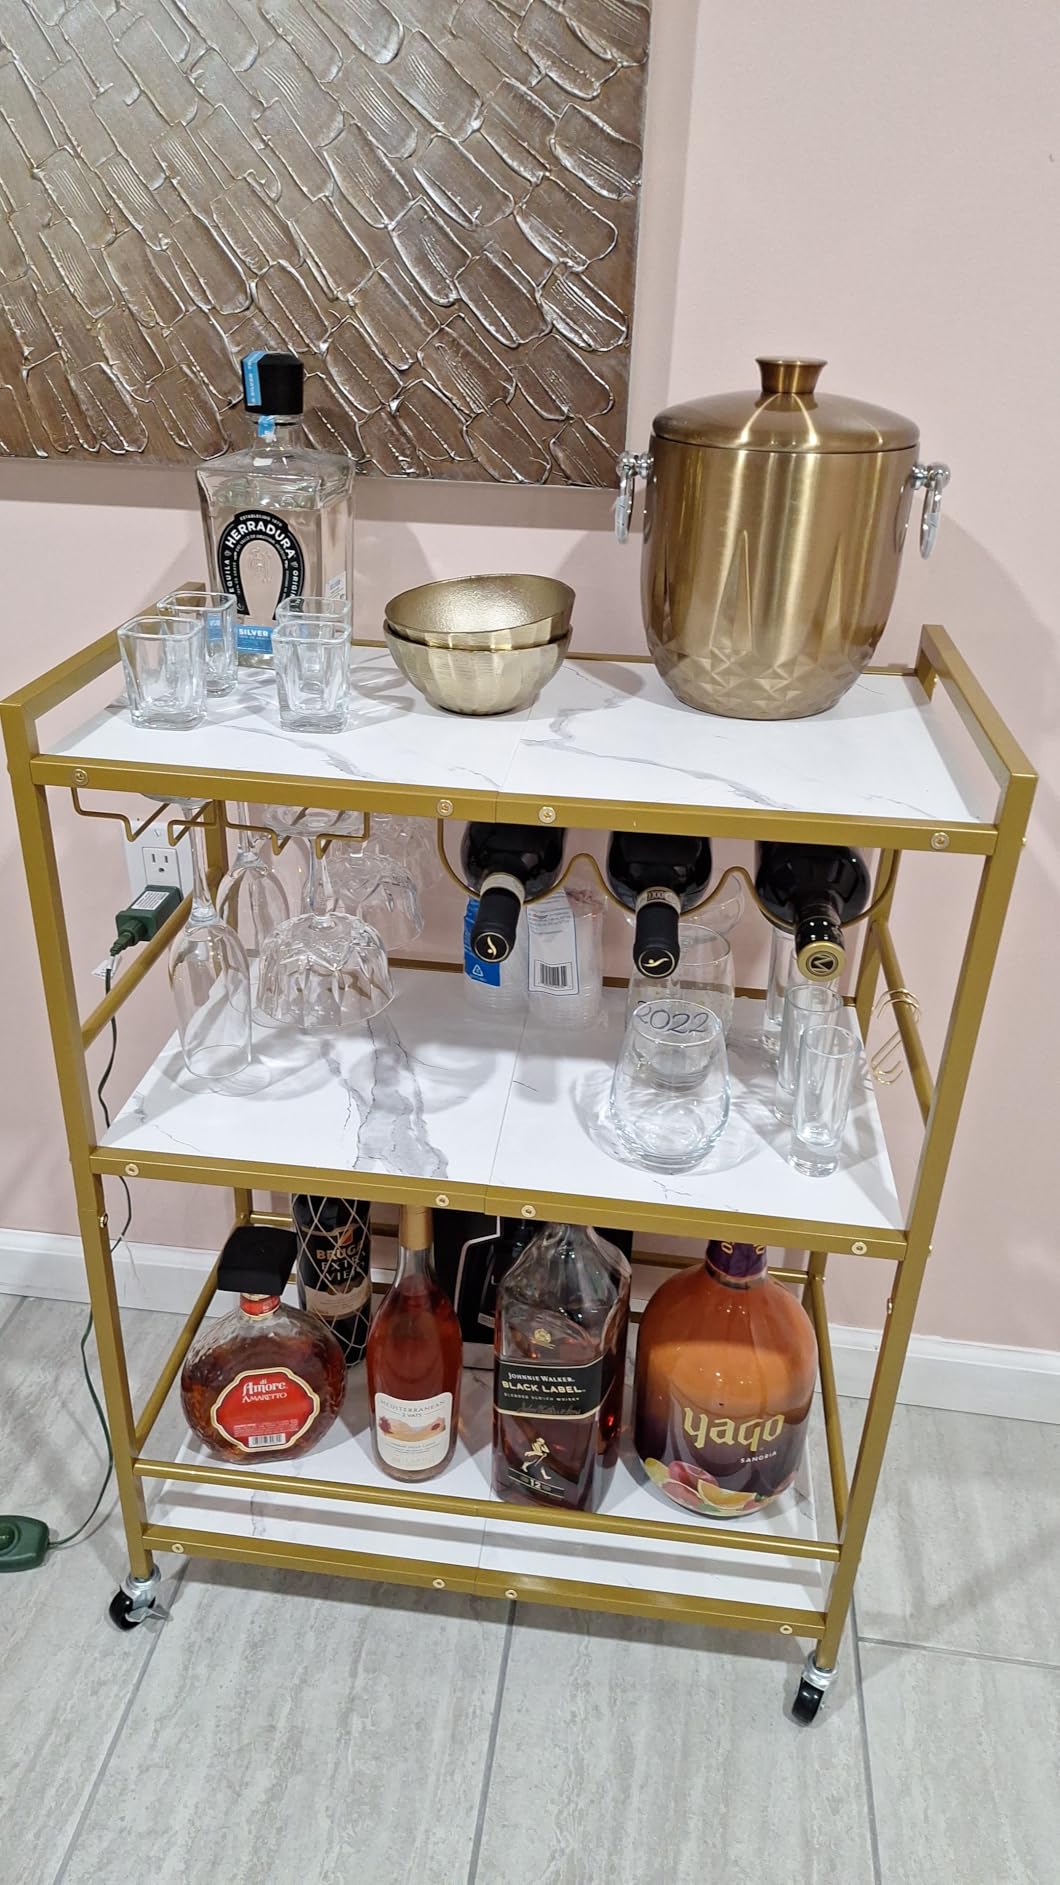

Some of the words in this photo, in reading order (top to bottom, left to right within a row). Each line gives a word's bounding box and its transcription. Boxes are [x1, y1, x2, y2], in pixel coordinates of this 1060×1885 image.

[225, 521, 295, 559] HERRADURA
[223, 559, 235, 593] EQUILA
[238, 628, 269, 637] SILVER
[636, 1000, 707, 1034] 2022
[260, 1378, 267, 1386] di
[508, 1372, 540, 1381] JOHNNIE
[540, 1375, 574, 1383] WALKER
[241, 1381, 286, 1397] Amore
[502, 1380, 539, 1392] BLACK
[541, 1385, 583, 1394] LABEL
[241, 1392, 288, 1404] AMARETTO
[380, 1399, 445, 1412] MEDITERRANEAN
[740, 1450, 777, 1464] SANGRIA
[530, 1479, 541, 1489] 12
